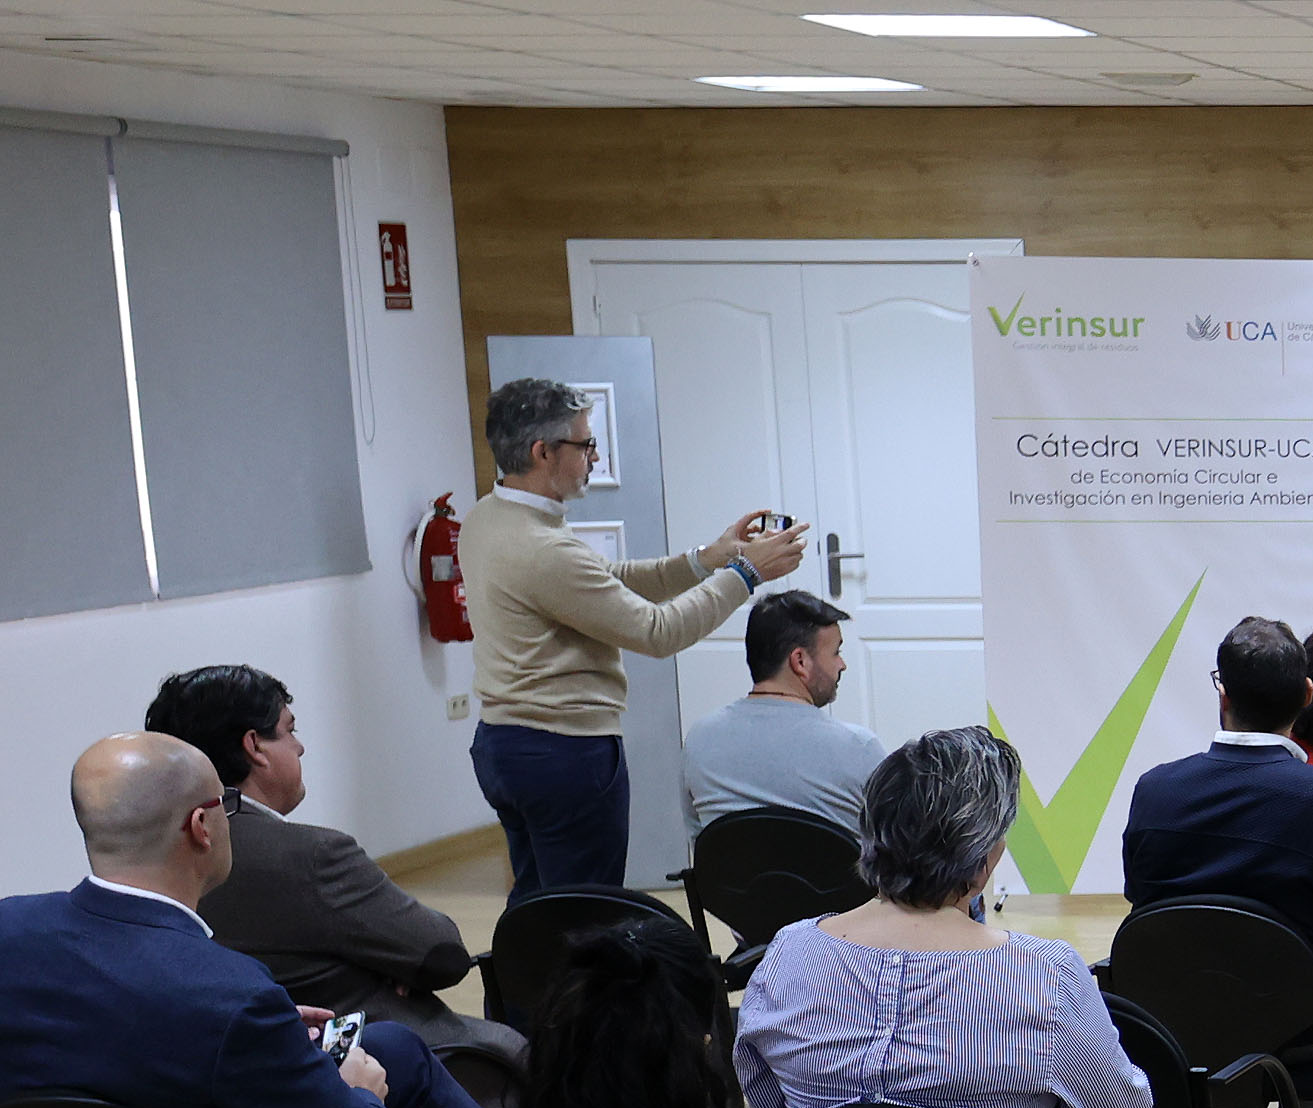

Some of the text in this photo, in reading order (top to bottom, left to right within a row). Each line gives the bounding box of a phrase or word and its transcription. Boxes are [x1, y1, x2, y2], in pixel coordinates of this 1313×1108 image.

[987, 290, 1145, 338] Verinsur
[1224, 321, 1278, 341] UCA
[1016, 433, 1139, 459] Cátedra
[1070, 468, 1278, 485] de Economía Circular e
[1009, 490, 1127, 508] Investigación
[1131, 494, 1151, 506] en
